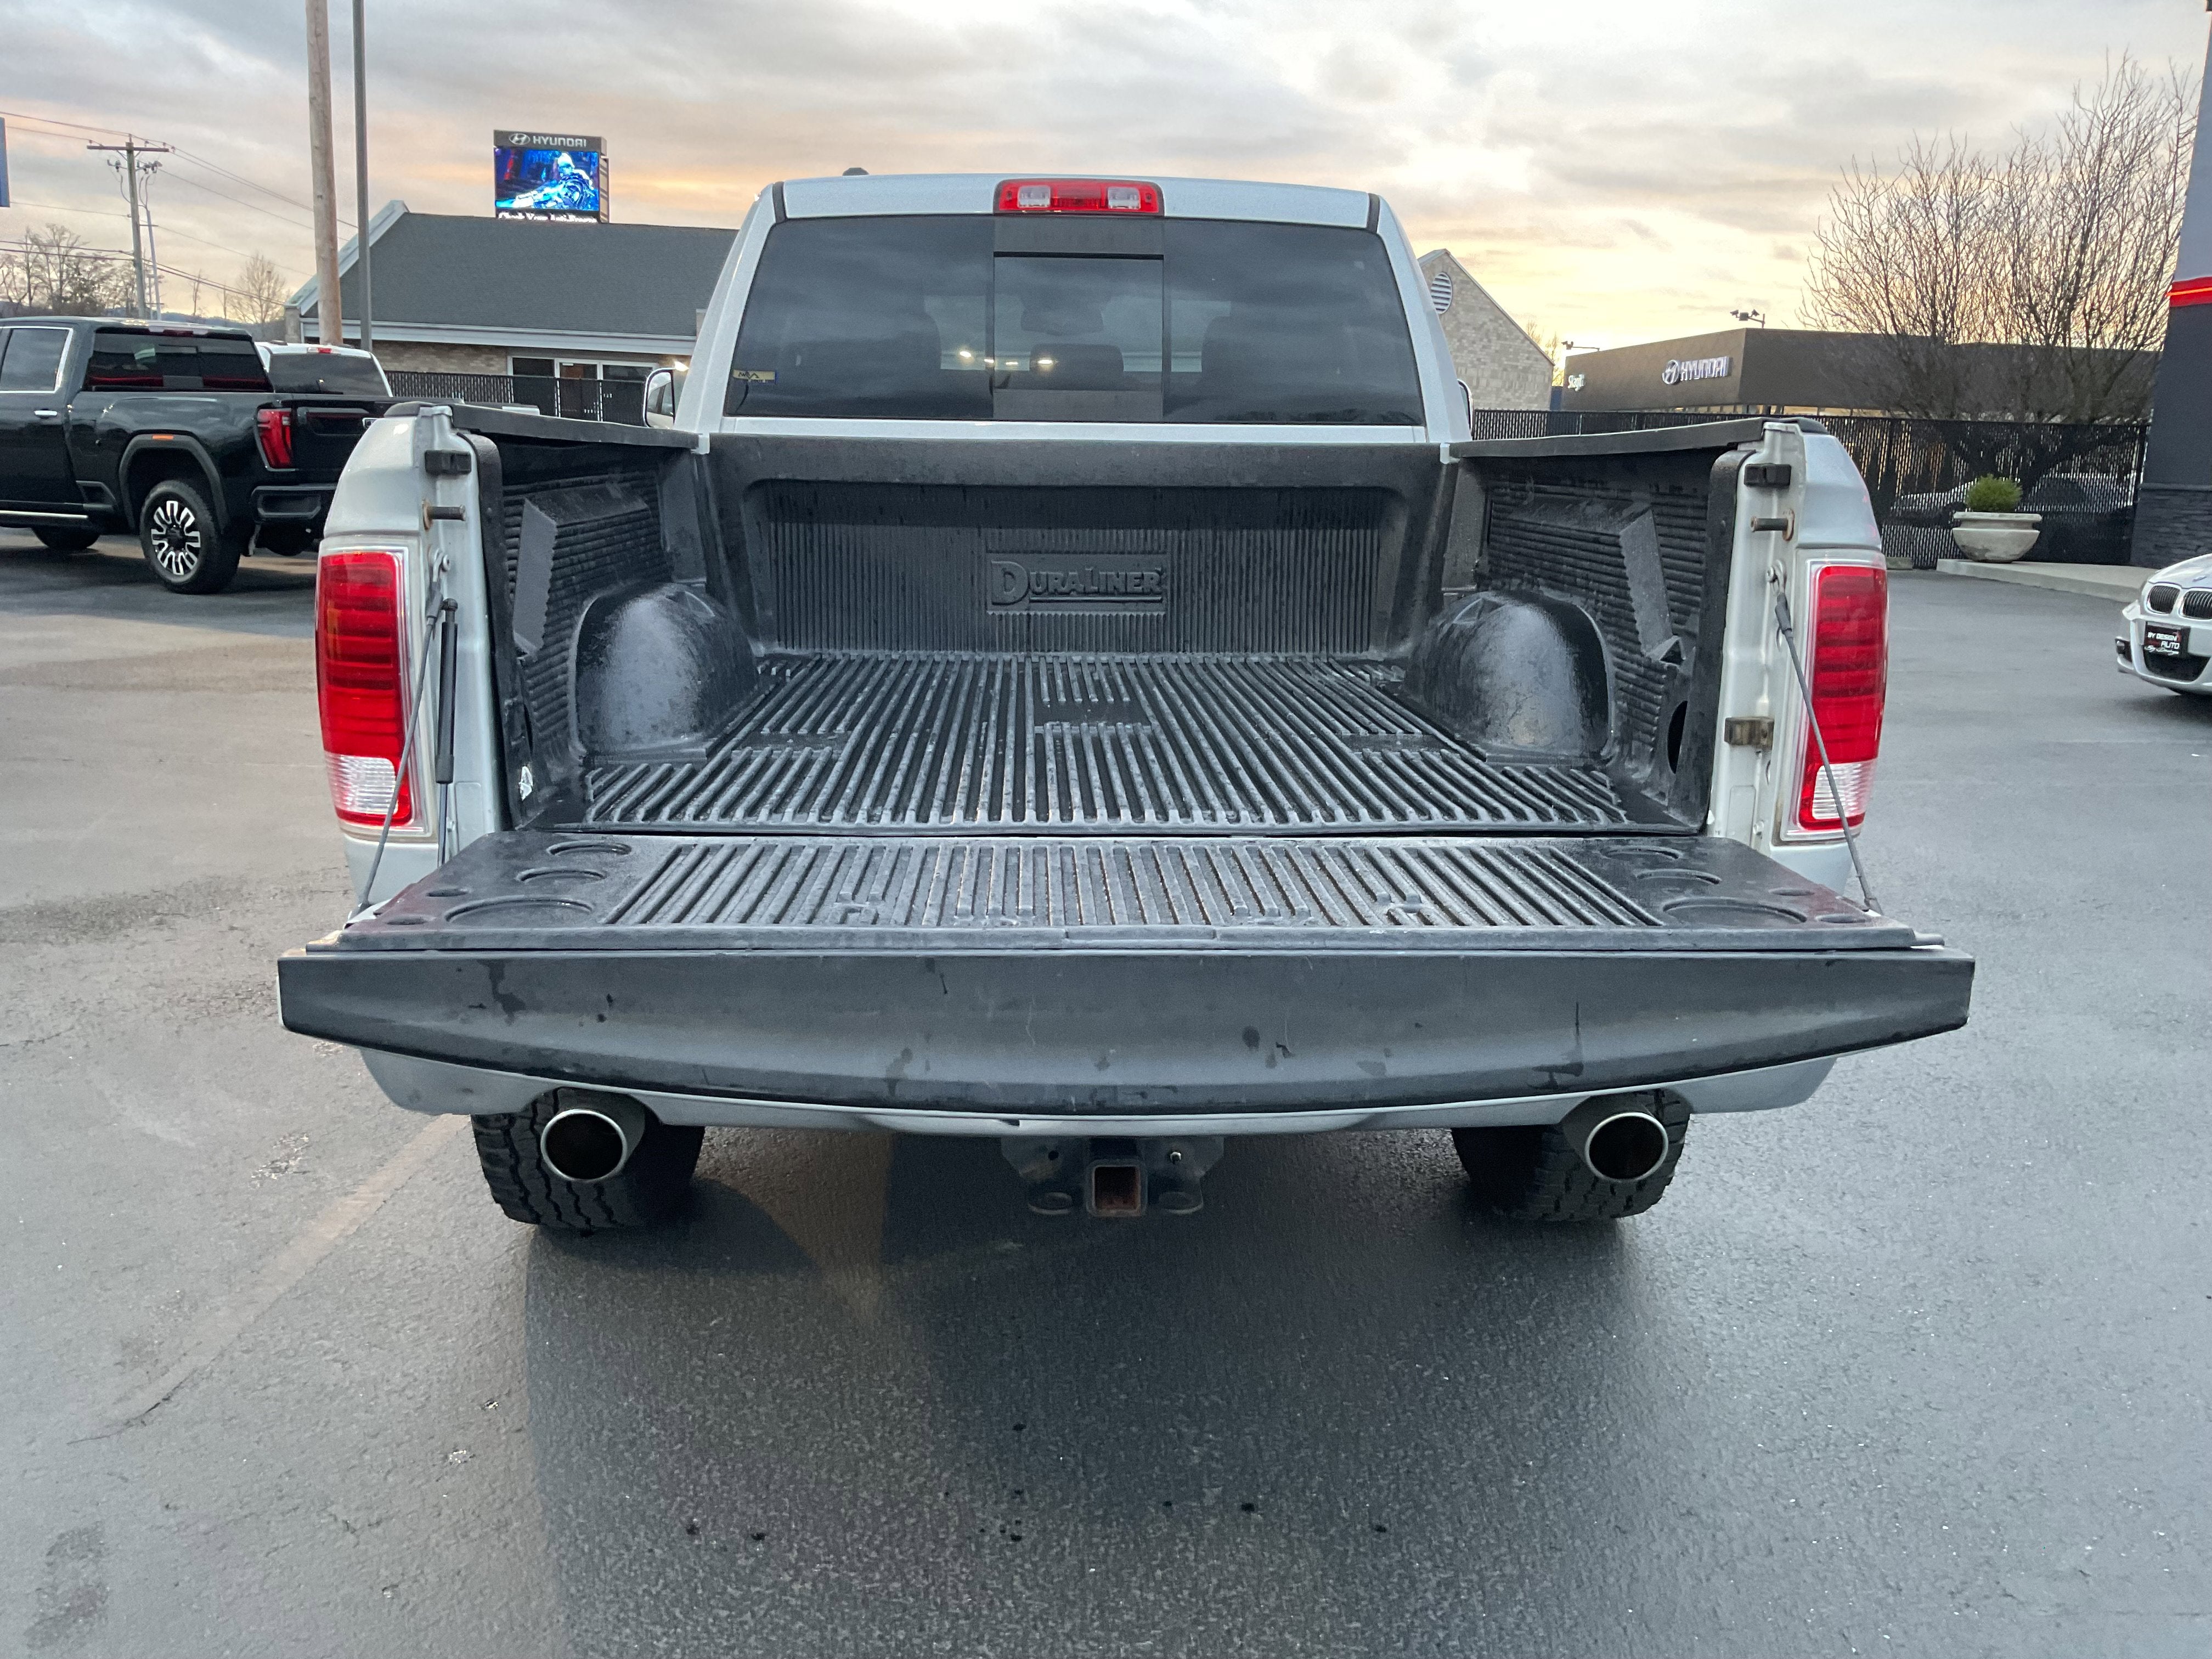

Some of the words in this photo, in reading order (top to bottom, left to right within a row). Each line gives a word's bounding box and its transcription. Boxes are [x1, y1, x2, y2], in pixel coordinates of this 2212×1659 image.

[533, 136, 586, 147] HYUNDAI
[1680, 356, 1729, 381] HYUNDAI
[2161, 641, 2180, 650] AUTO
